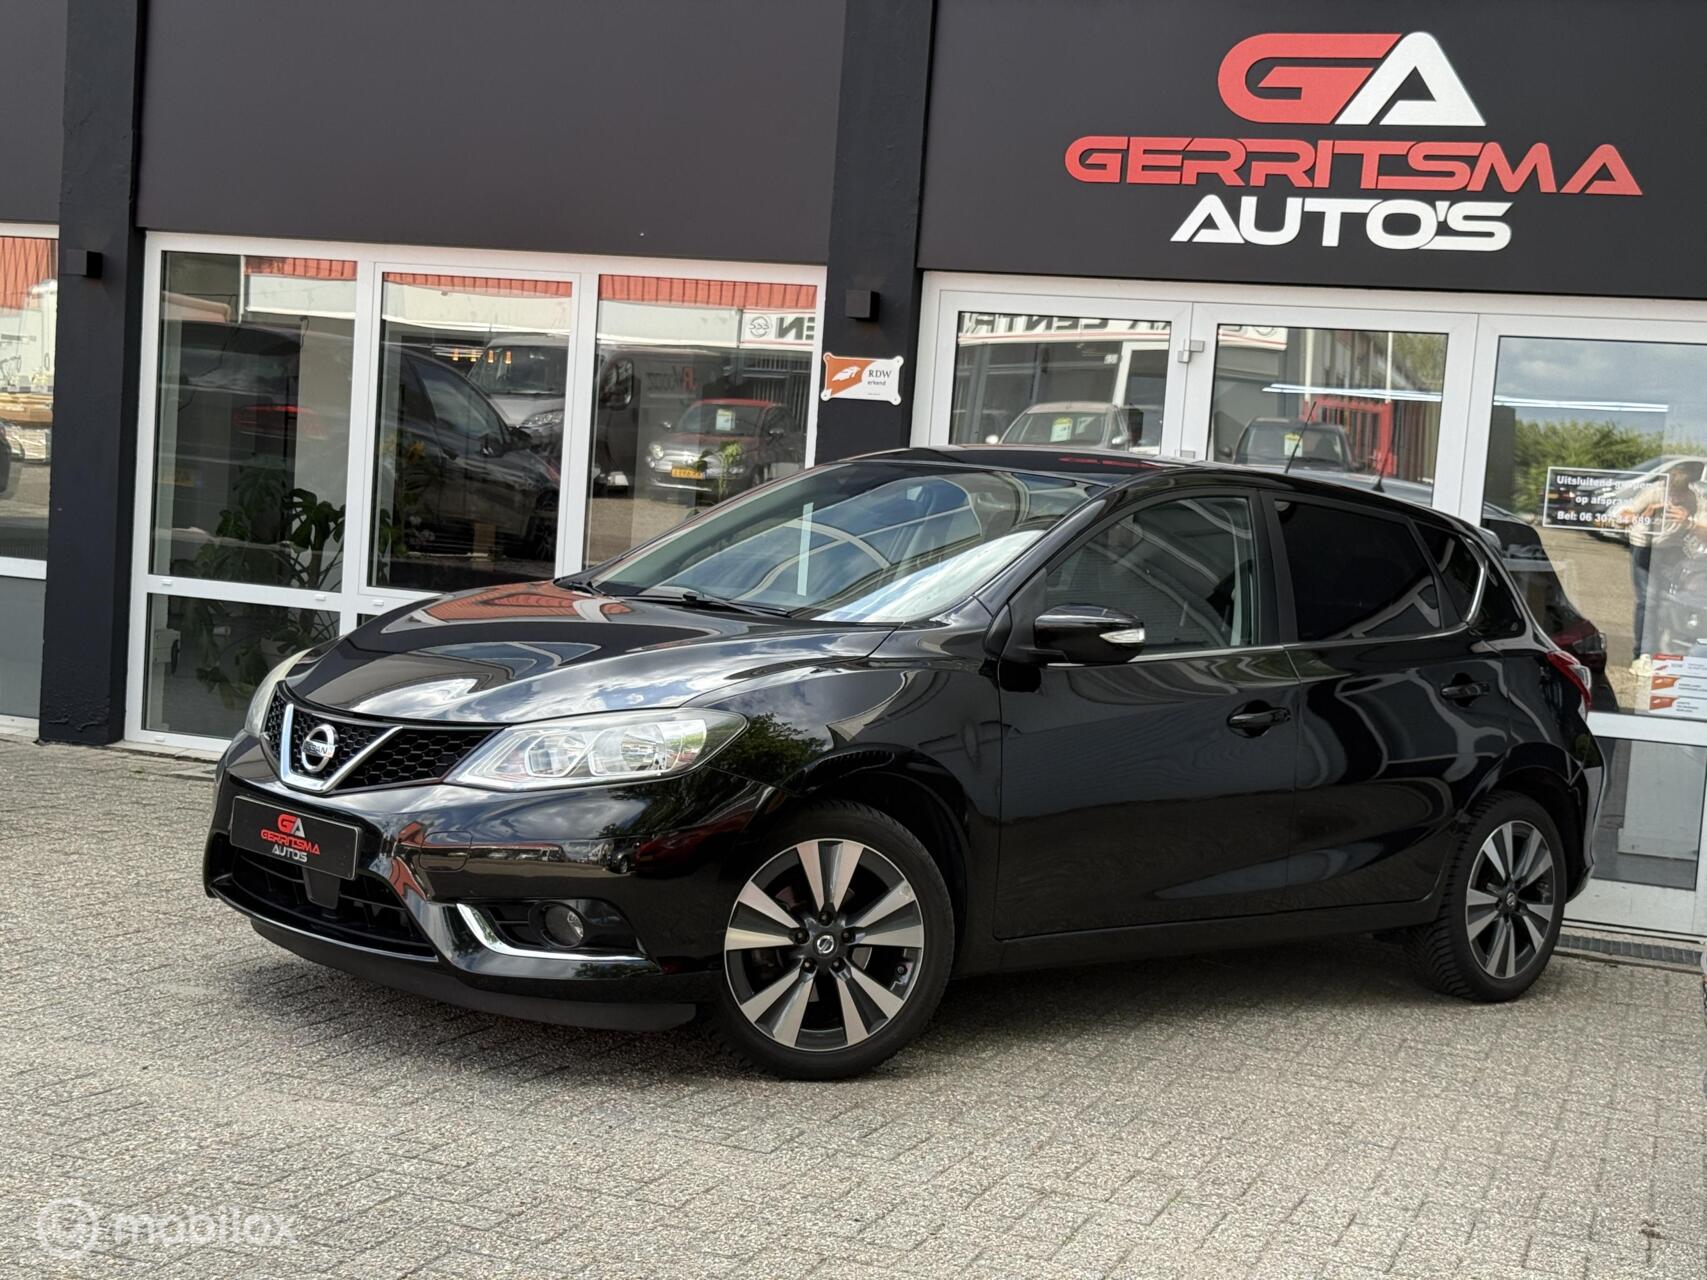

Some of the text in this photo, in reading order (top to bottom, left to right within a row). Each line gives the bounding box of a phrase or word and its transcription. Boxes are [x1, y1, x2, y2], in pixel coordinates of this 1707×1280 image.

[1217, 31, 1486, 127] GA
[1064, 135, 1643, 196] GERRITSMA
[1170, 193, 1513, 252] AUTO'S
[867, 379, 887, 387] erkend
[868, 369, 892, 379] RDW
[1556, 475, 1612, 487] Uitsluitend
[1575, 496, 1588, 506] op
[1557, 511, 1577, 521] Bel:
[1579, 512, 1592, 521] 06
[278, 814, 305, 838] GA
[261, 829, 320, 854] GERRITSMA
[272, 844, 307, 862] AUTOS
